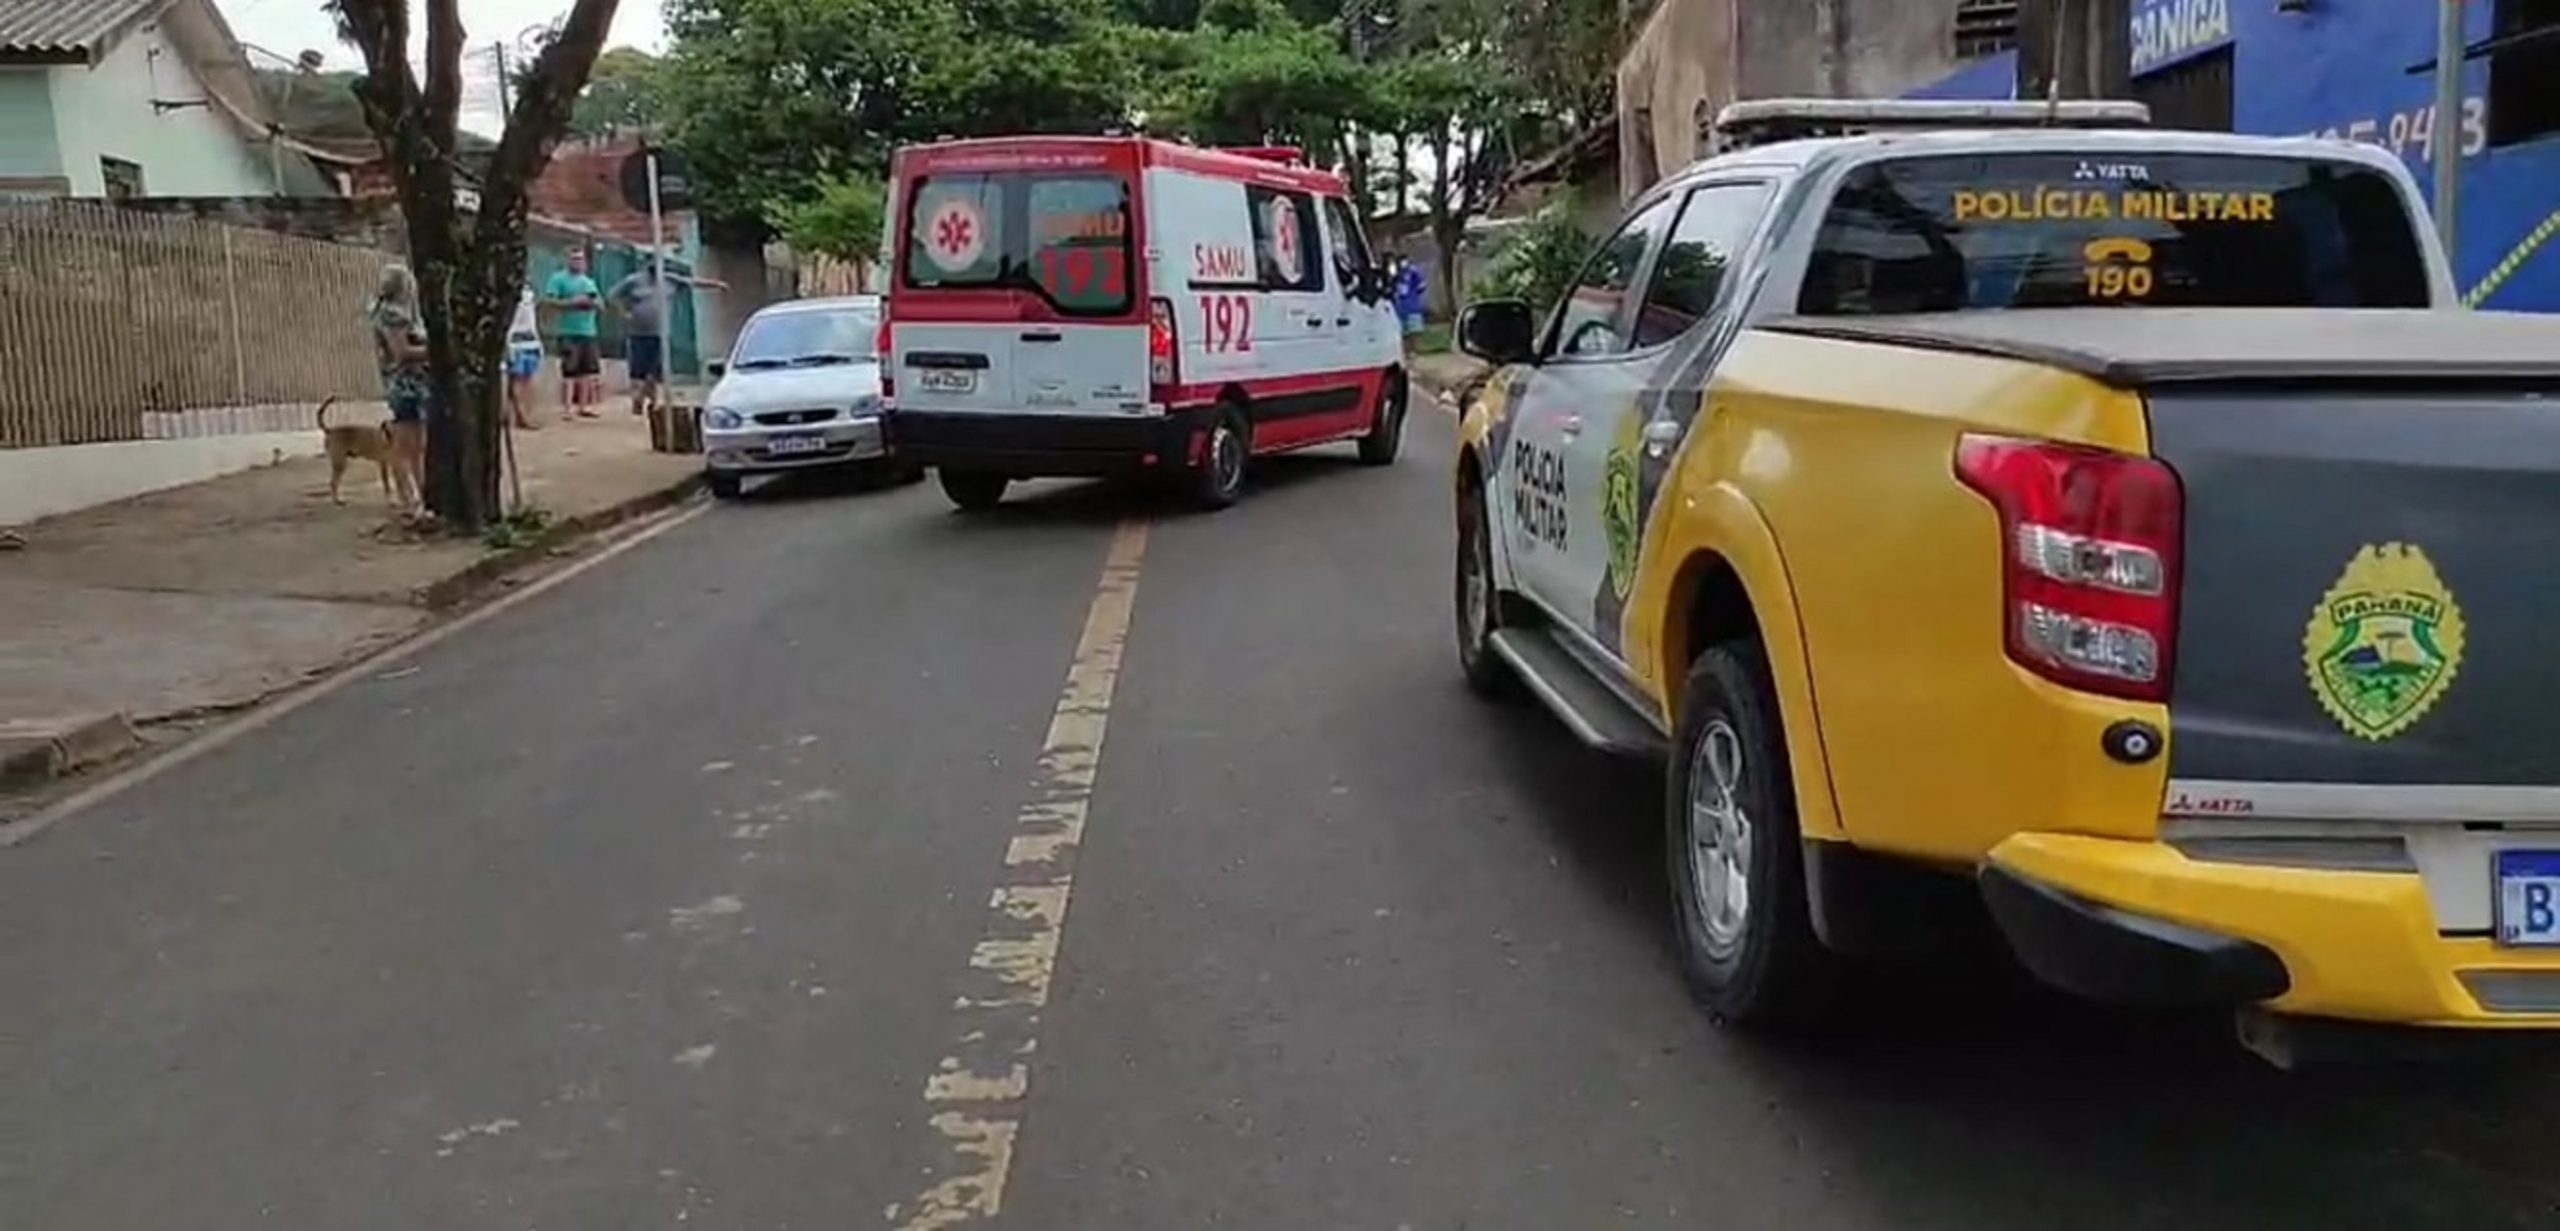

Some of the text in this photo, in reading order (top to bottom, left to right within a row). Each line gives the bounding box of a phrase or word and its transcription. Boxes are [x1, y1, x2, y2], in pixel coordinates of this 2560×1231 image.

[2098, 165, 2149, 181] YATTA
[1954, 184, 2274, 222] POLÍCIA MILITAR
[1035, 246, 1124, 296] 192
[1194, 243, 1246, 277] SAMU
[2084, 264, 2152, 298] 190
[1201, 295, 1250, 353] 192
[1515, 487, 1568, 553] MILITAR
